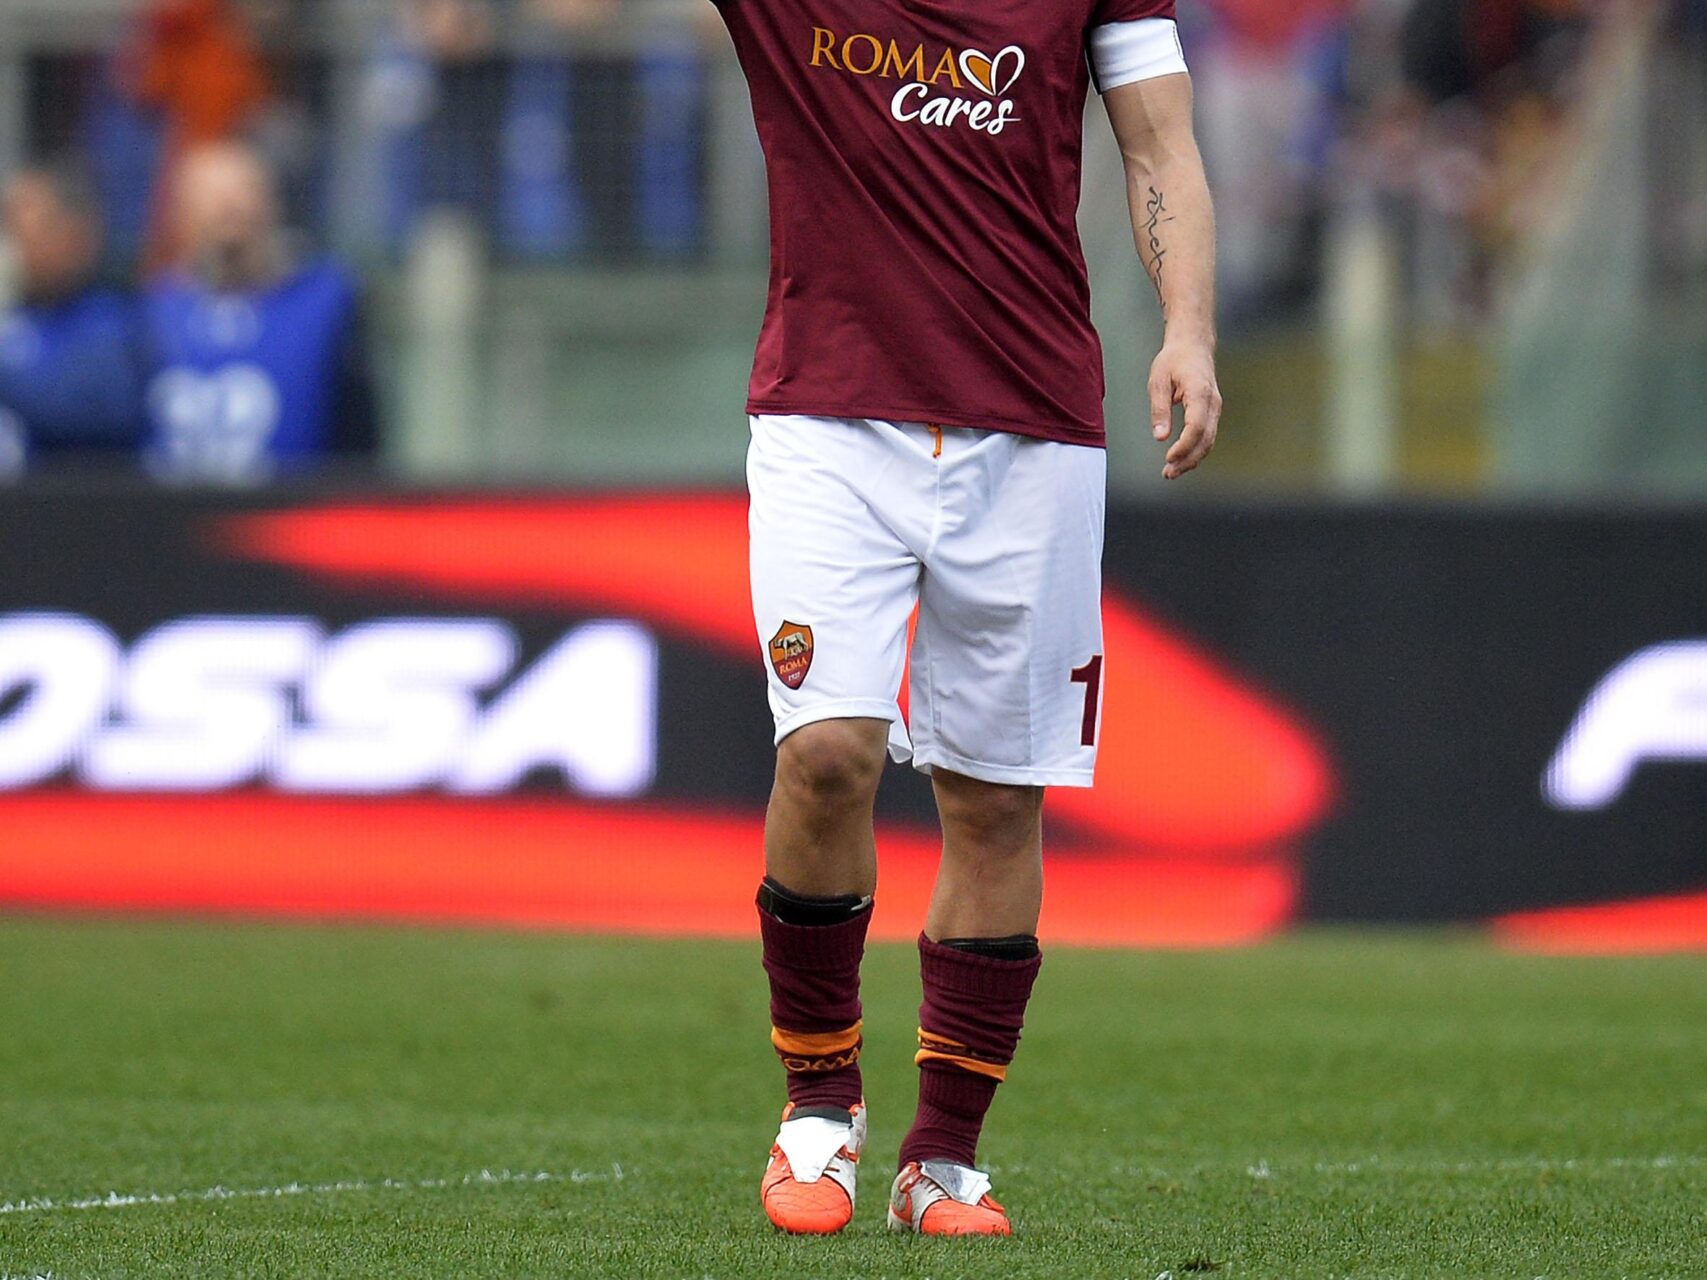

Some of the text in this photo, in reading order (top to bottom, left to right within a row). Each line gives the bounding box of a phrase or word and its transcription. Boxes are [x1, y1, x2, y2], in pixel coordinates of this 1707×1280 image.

[809, 26, 964, 89] ROMA
[891, 83, 1022, 135] Cares
[779, 656, 808, 675] ROMA
